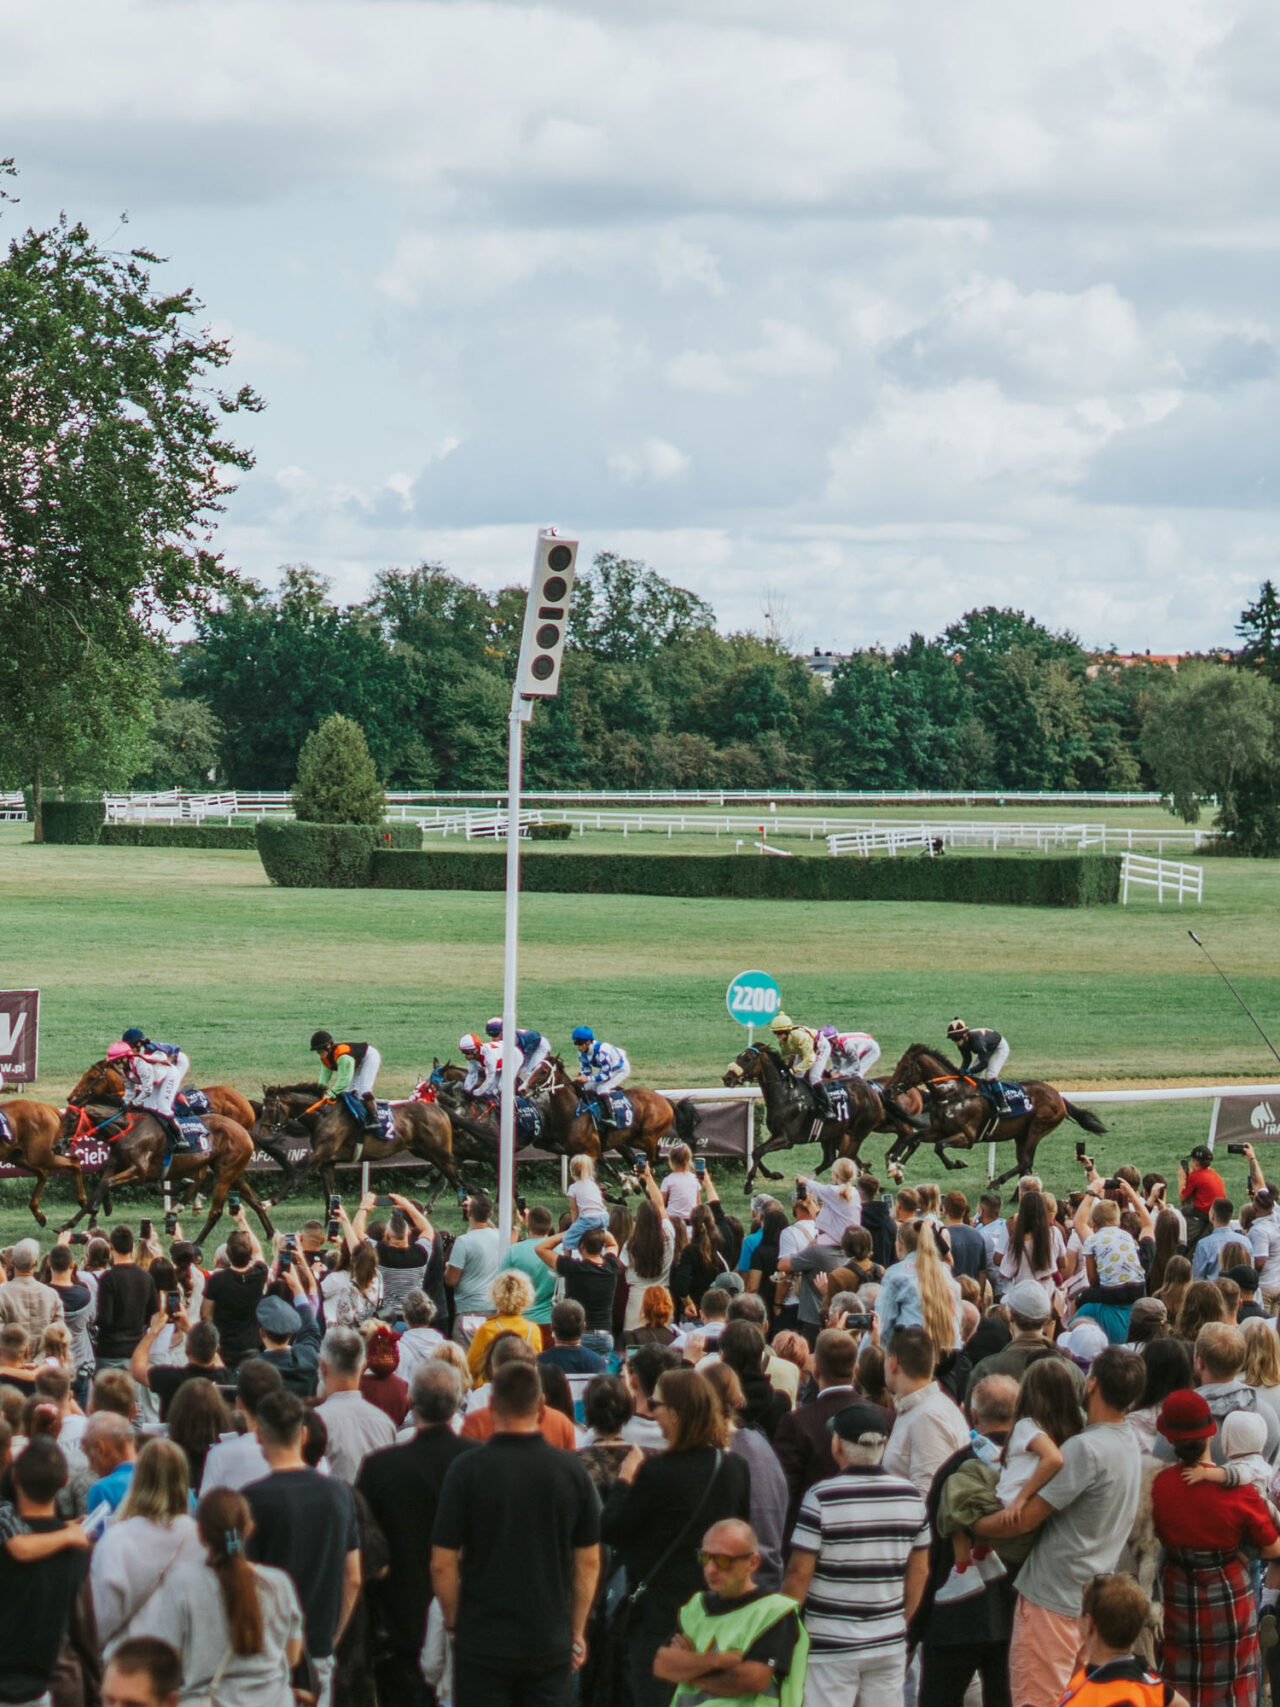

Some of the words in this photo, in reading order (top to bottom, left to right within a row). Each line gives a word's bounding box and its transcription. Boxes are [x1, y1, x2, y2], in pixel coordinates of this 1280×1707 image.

[732, 986, 776, 1013] 2200
[625, 1109, 633, 1126] 9
[837, 1101, 849, 1121] 11
[385, 1122, 394, 1139] 2
[534, 1119, 540, 1136] 5
